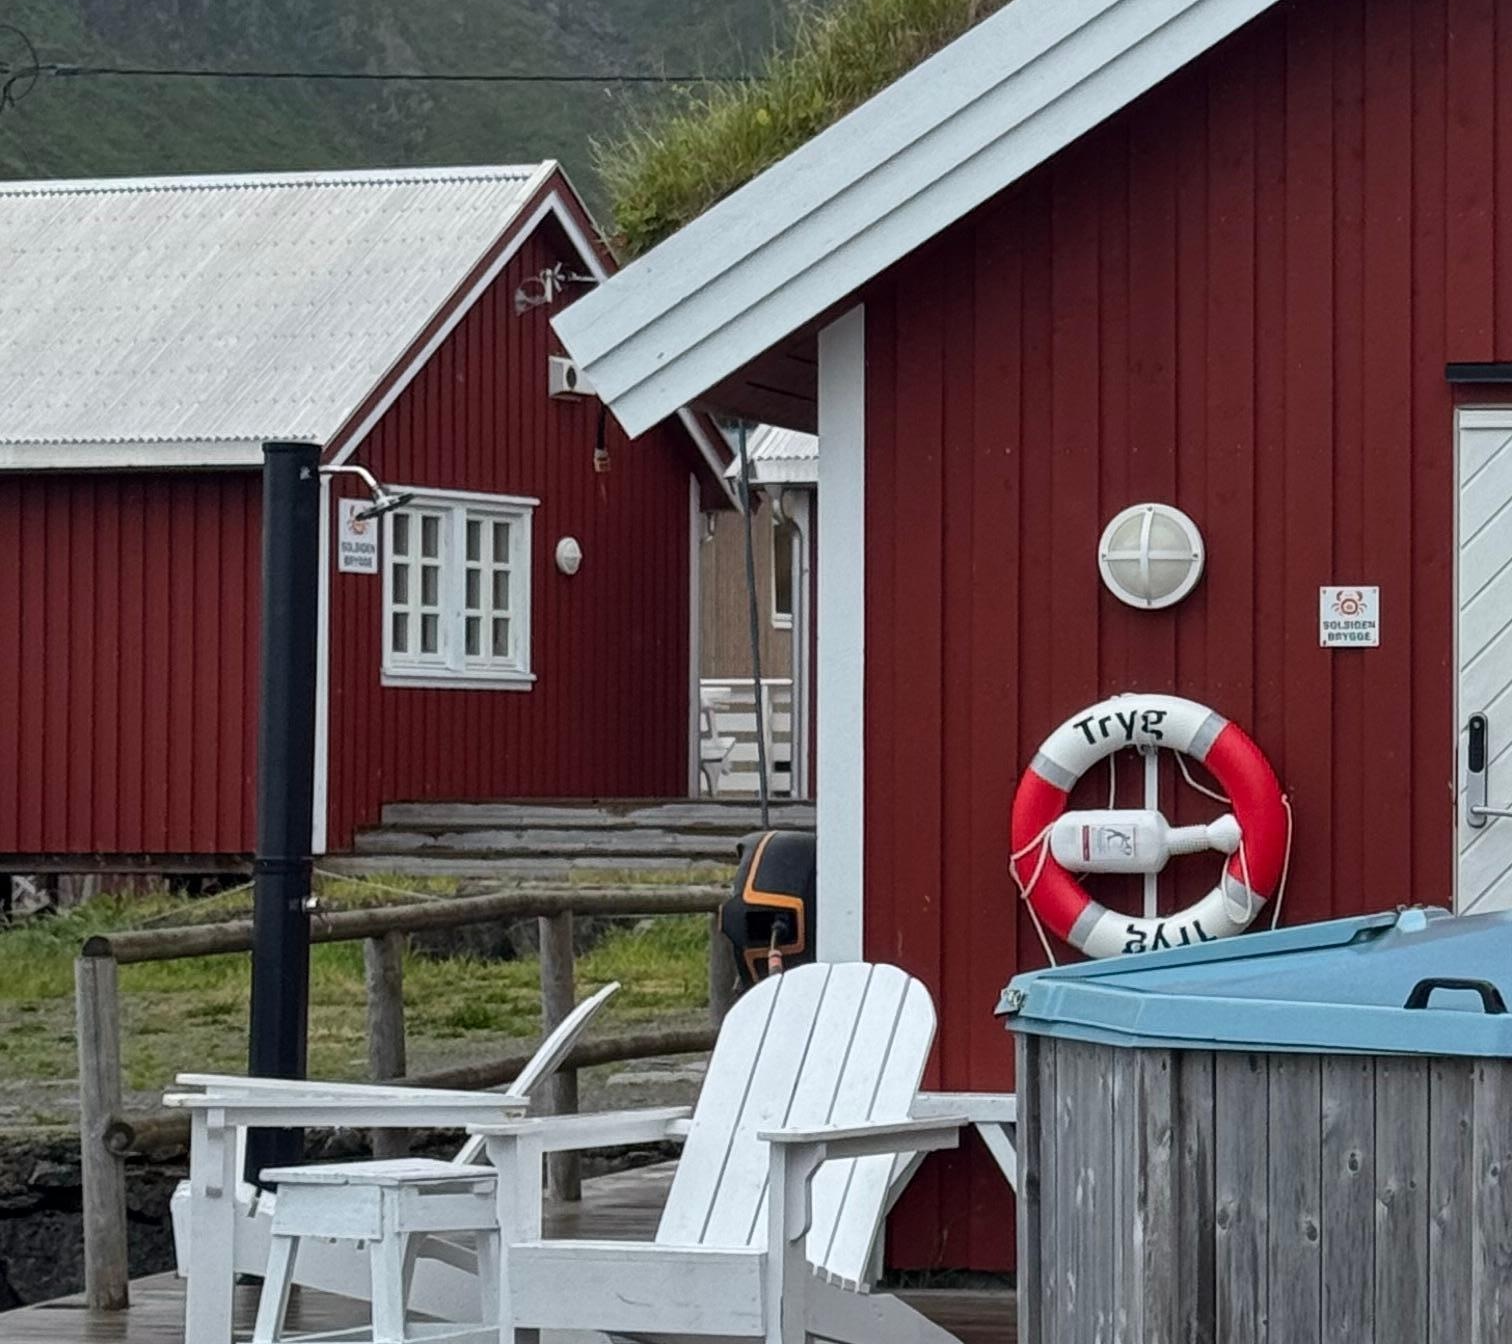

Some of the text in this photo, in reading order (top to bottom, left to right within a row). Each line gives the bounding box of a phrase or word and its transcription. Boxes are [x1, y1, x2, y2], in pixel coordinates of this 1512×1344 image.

[1323, 620, 1376, 630] SOLSIDEN
[1073, 710, 1167, 745] Tryg
[1121, 920, 1218, 954] Tryg
